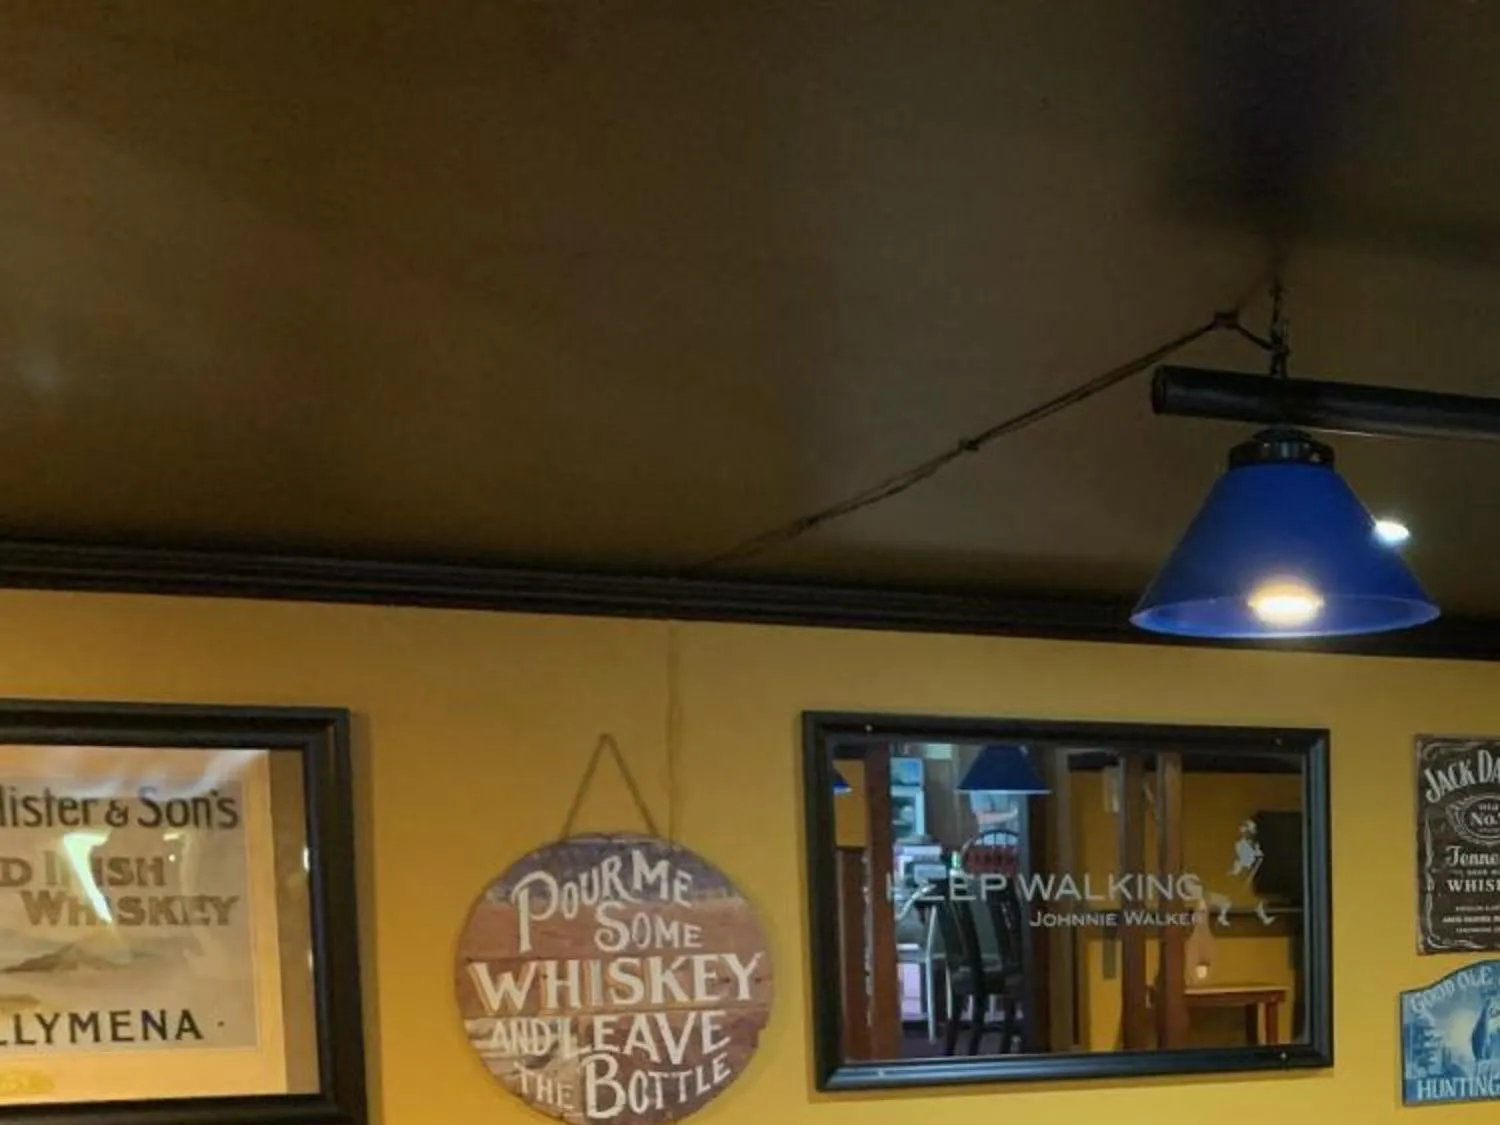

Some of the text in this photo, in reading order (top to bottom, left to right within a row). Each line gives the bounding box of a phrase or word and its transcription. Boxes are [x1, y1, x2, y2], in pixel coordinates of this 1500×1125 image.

[1424, 758, 1474, 803] JACK
[104, 799, 129, 828] &
[137, 785, 239, 829] Son's
[45, 851, 167, 887] IISH
[1017, 873, 1204, 902] WALKING
[20, 891, 240, 926] WHSKEY
[510, 849, 693, 953] POUR ME
[1029, 909, 1203, 927] JOHNNIE WALKER
[594, 900, 703, 952] SOME
[465, 952, 765, 1016] WHISKEY
[0, 1009, 204, 1046] LYMENA
[559, 1010, 731, 1065] LEAVE
[513, 1053, 732, 1119] THE BOTTLE
[1417, 1075, 1500, 1100] HUNTING
